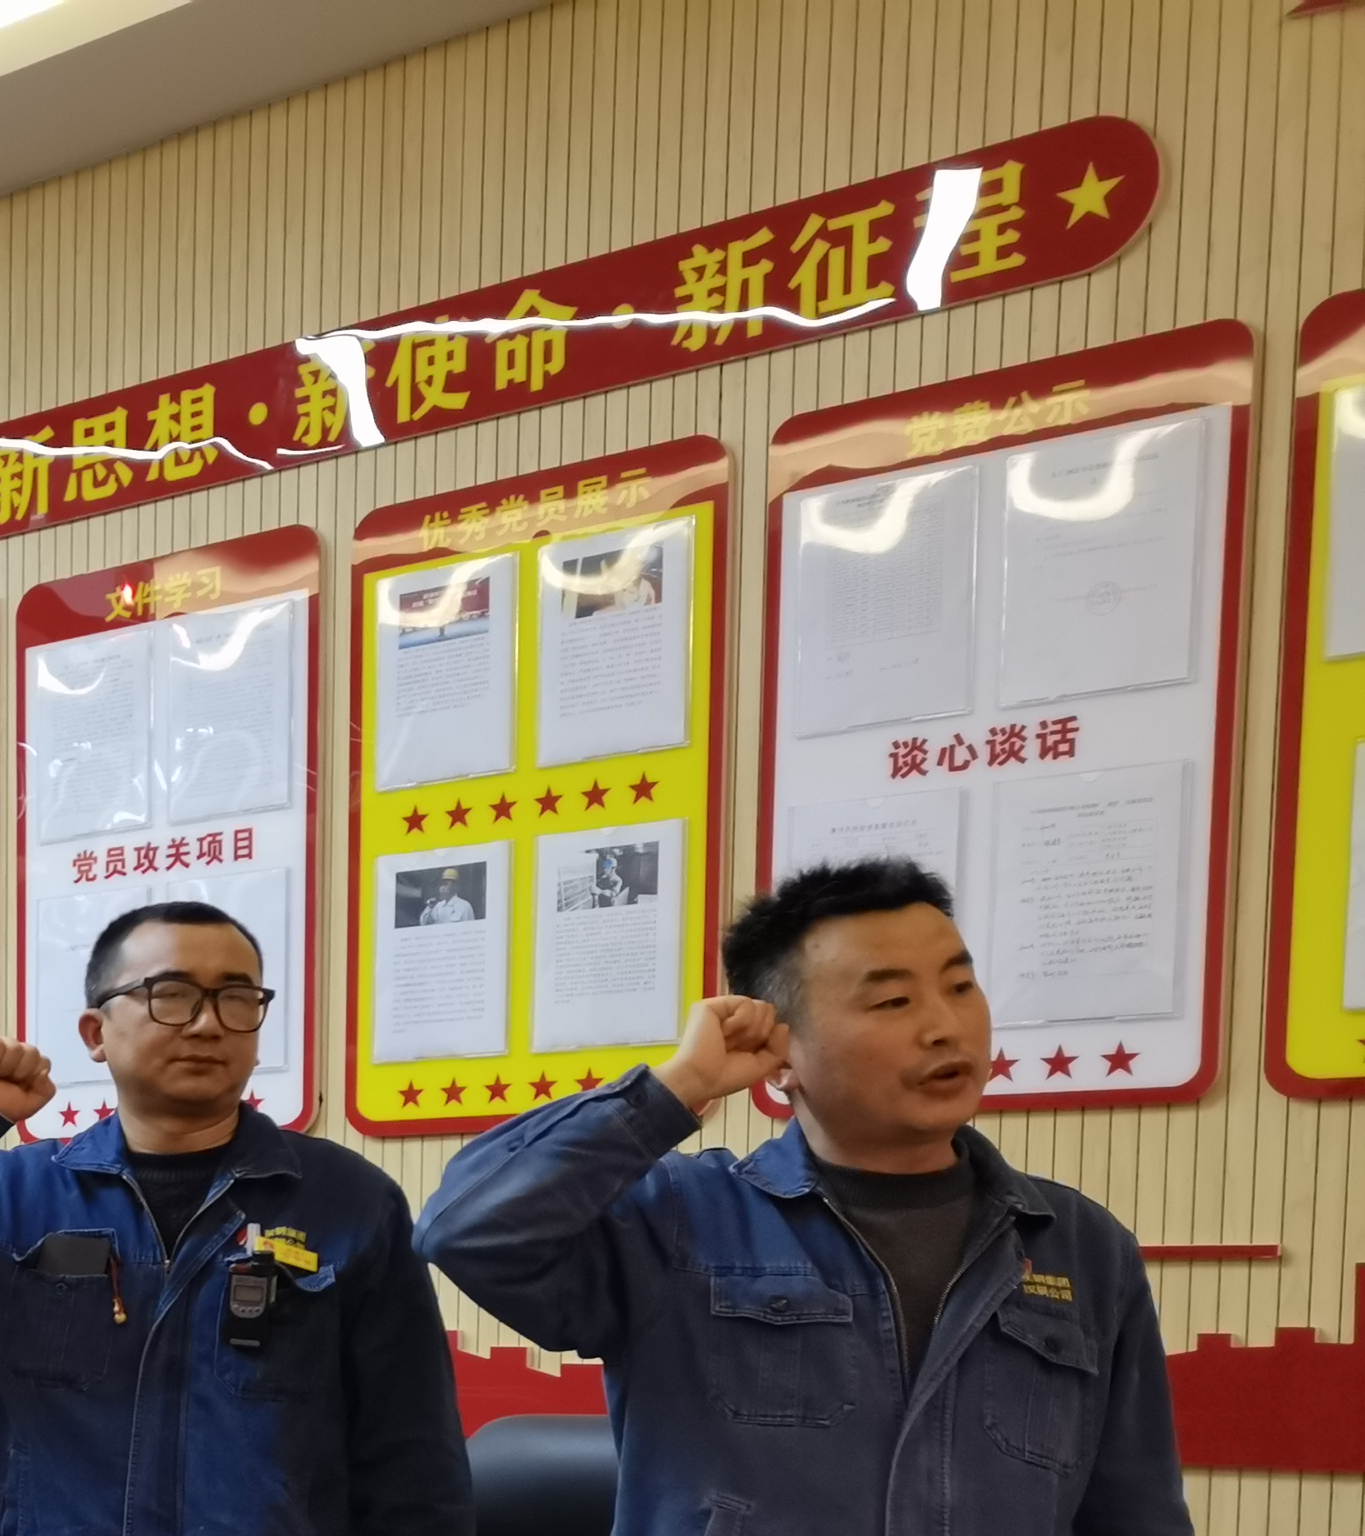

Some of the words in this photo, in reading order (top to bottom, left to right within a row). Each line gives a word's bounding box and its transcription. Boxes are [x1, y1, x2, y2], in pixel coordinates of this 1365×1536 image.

[901, 377, 1093, 457] 党费公示
[419, 470, 651, 550] 优秀党员展示
[104, 565, 223, 622] 文件学习
[887, 713, 1082, 781] 谈心谈话
[72, 827, 256, 884] 党员攻关项目
